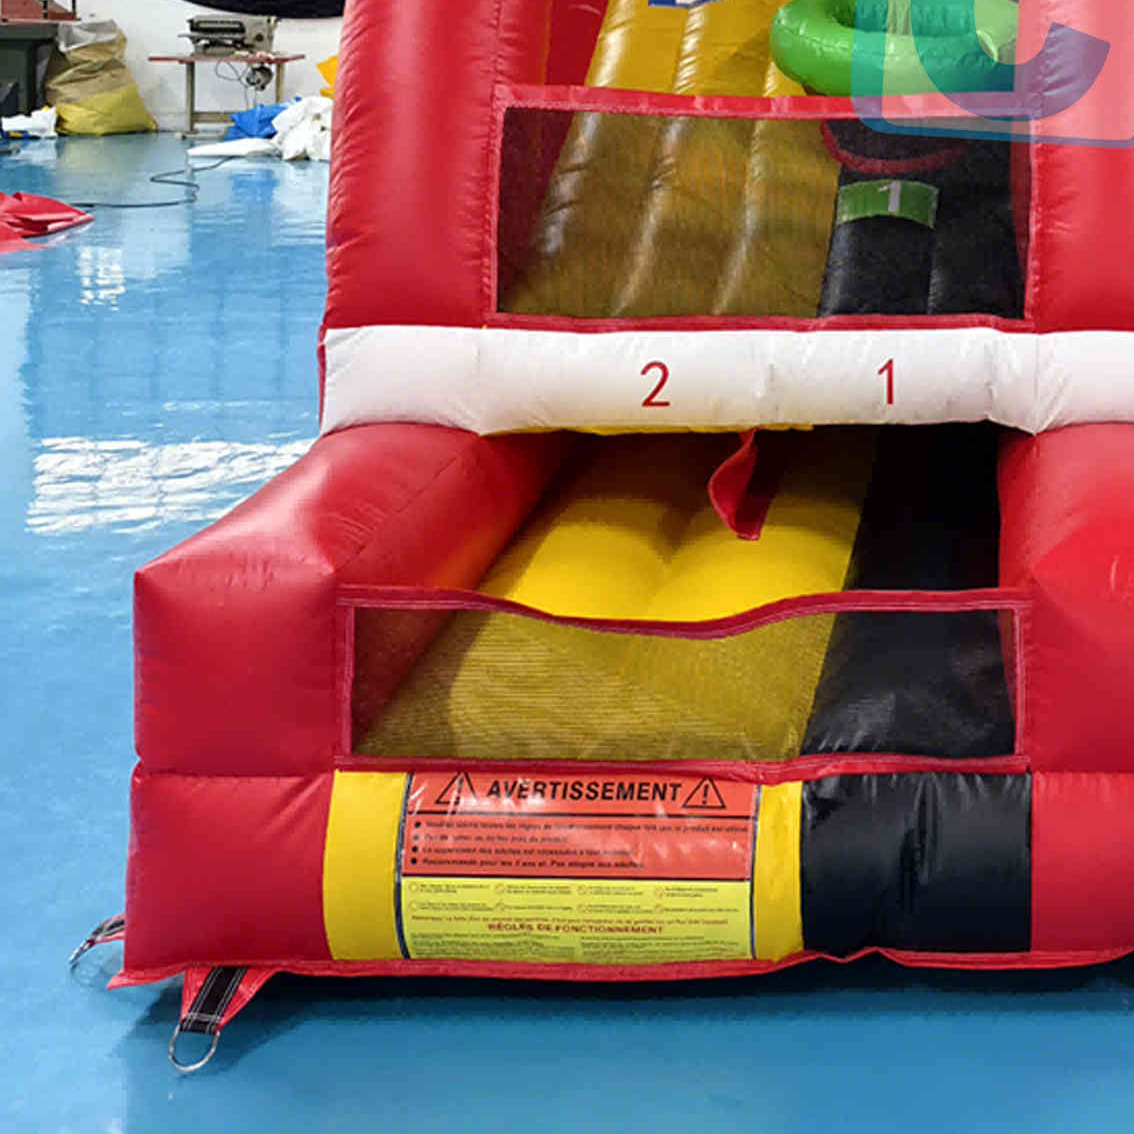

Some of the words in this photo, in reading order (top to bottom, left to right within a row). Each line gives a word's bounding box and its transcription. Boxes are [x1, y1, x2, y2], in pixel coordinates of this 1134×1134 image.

[877, 181, 902, 214] 1
[640, 360, 671, 408] 2
[877, 358, 894, 406] 1
[486, 780, 683, 803] AVERTISSEMENT
